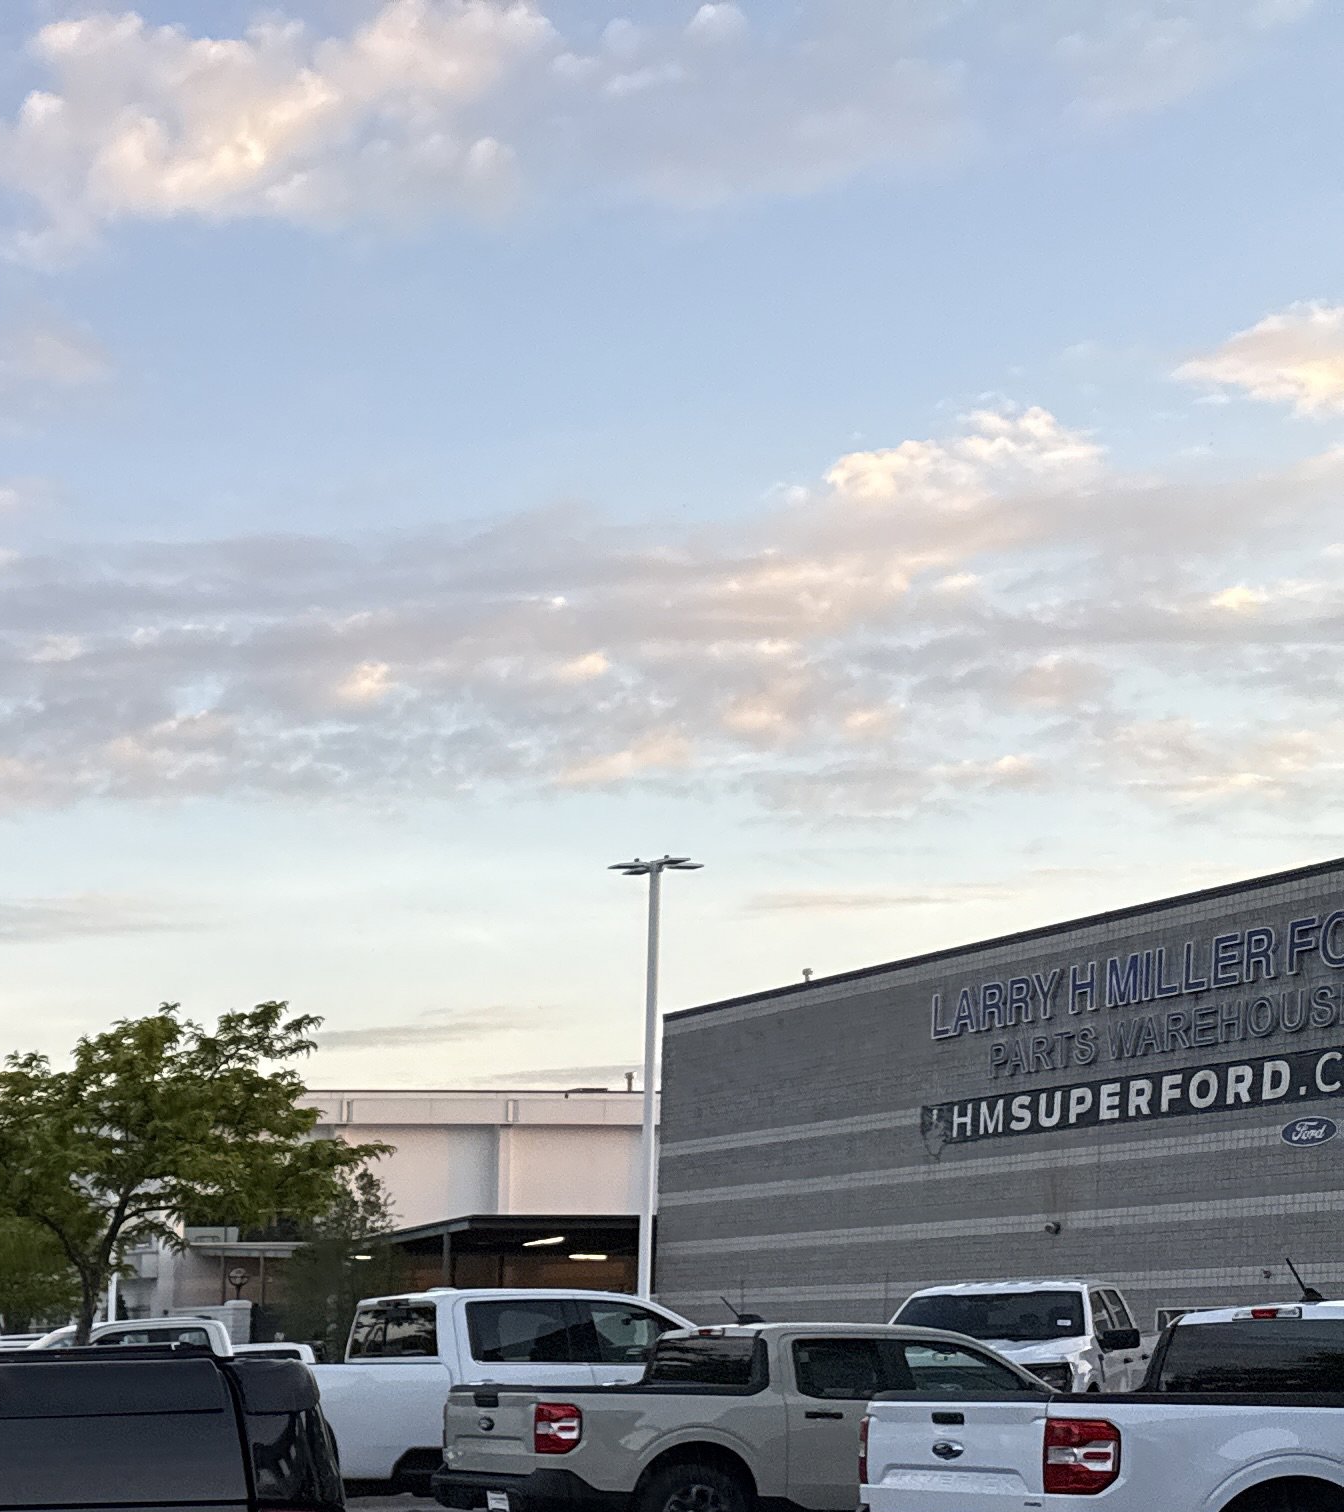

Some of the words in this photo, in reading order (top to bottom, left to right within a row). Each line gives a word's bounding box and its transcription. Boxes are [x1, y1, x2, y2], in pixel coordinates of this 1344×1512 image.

[931, 968, 1060, 1040] LARRY
[1068, 961, 1097, 1015] H
[1105, 926, 1276, 1007] MILLER
[988, 1026, 1096, 1079] PARTS
[1108, 983, 1344, 1059] WAREHOUS
[1292, 1120, 1327, 1142] Ford
